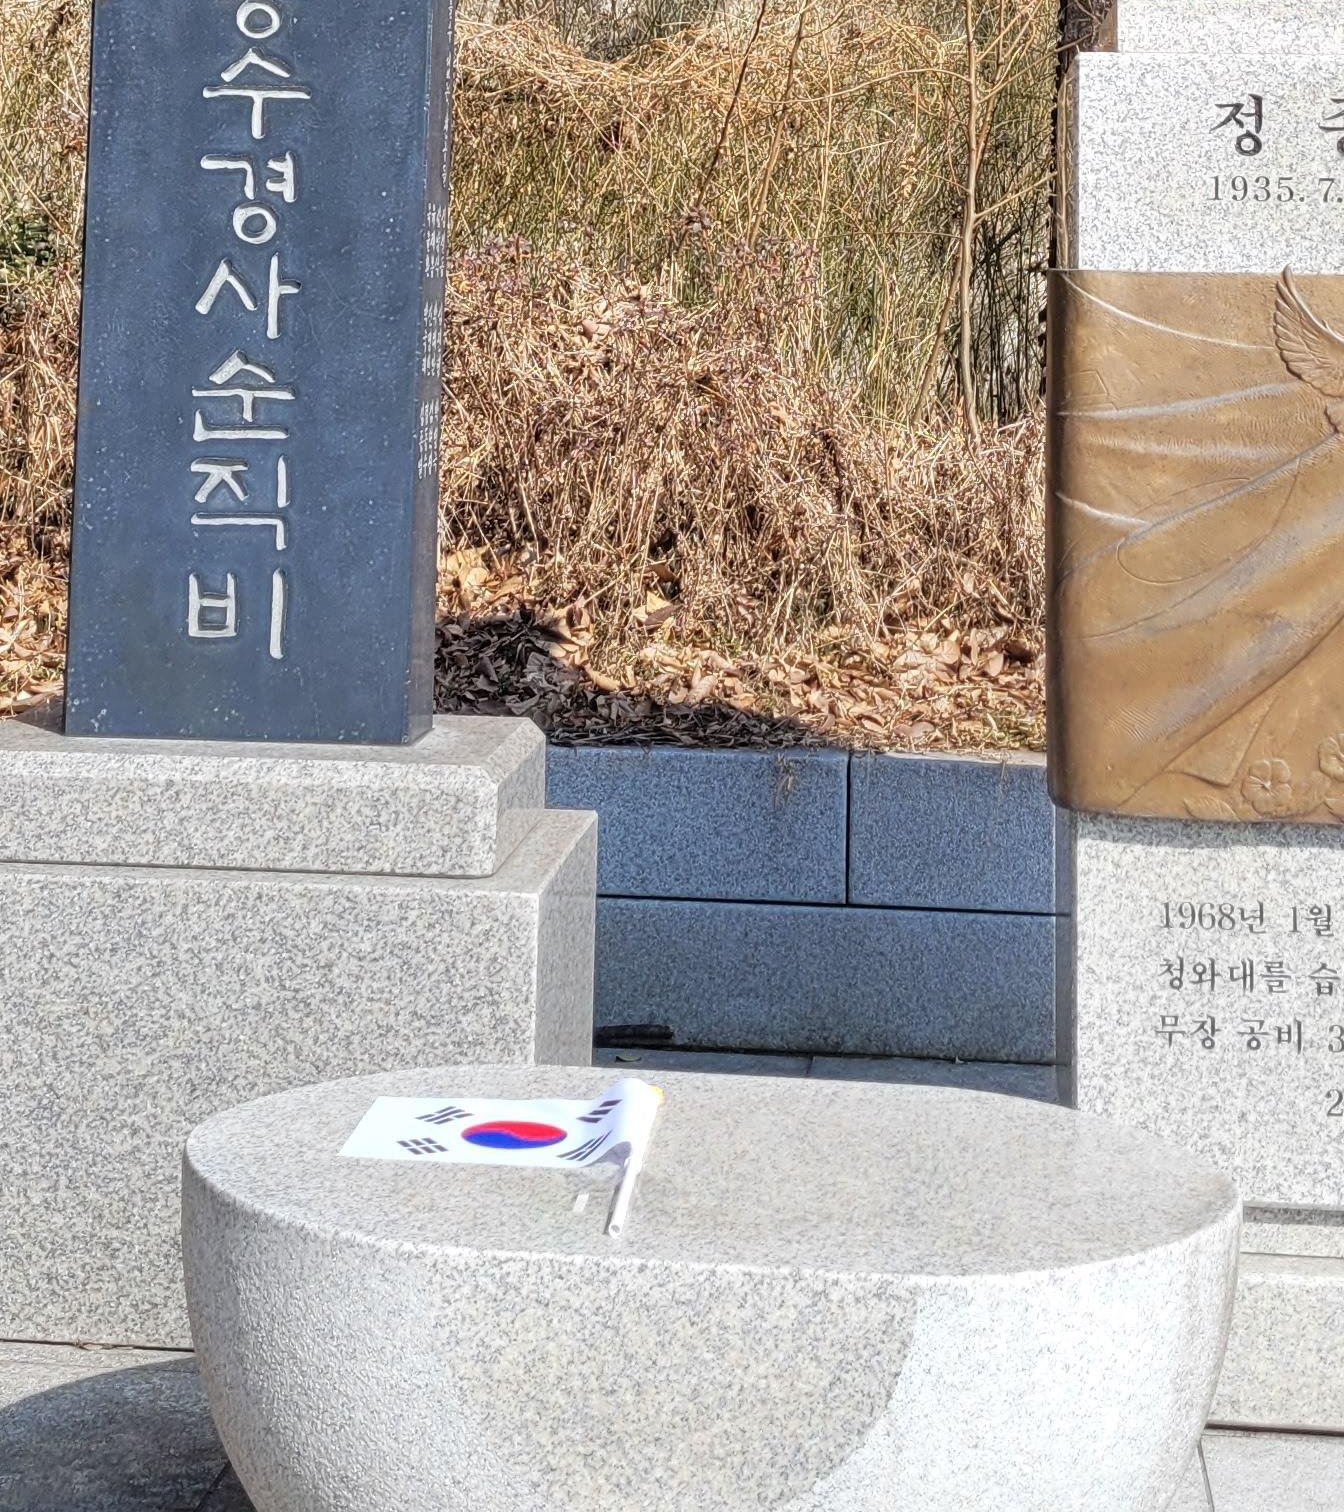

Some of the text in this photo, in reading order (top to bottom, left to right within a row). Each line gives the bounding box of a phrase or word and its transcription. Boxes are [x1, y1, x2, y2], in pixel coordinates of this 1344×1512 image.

[1160, 900, 1267, 935] 1968년
[1288, 903, 1335, 938] 1월
[1158, 956, 1292, 994] 청와대를
[1155, 1014, 1221, 1050] 무장
[1237, 1017, 1303, 1055] 공비
